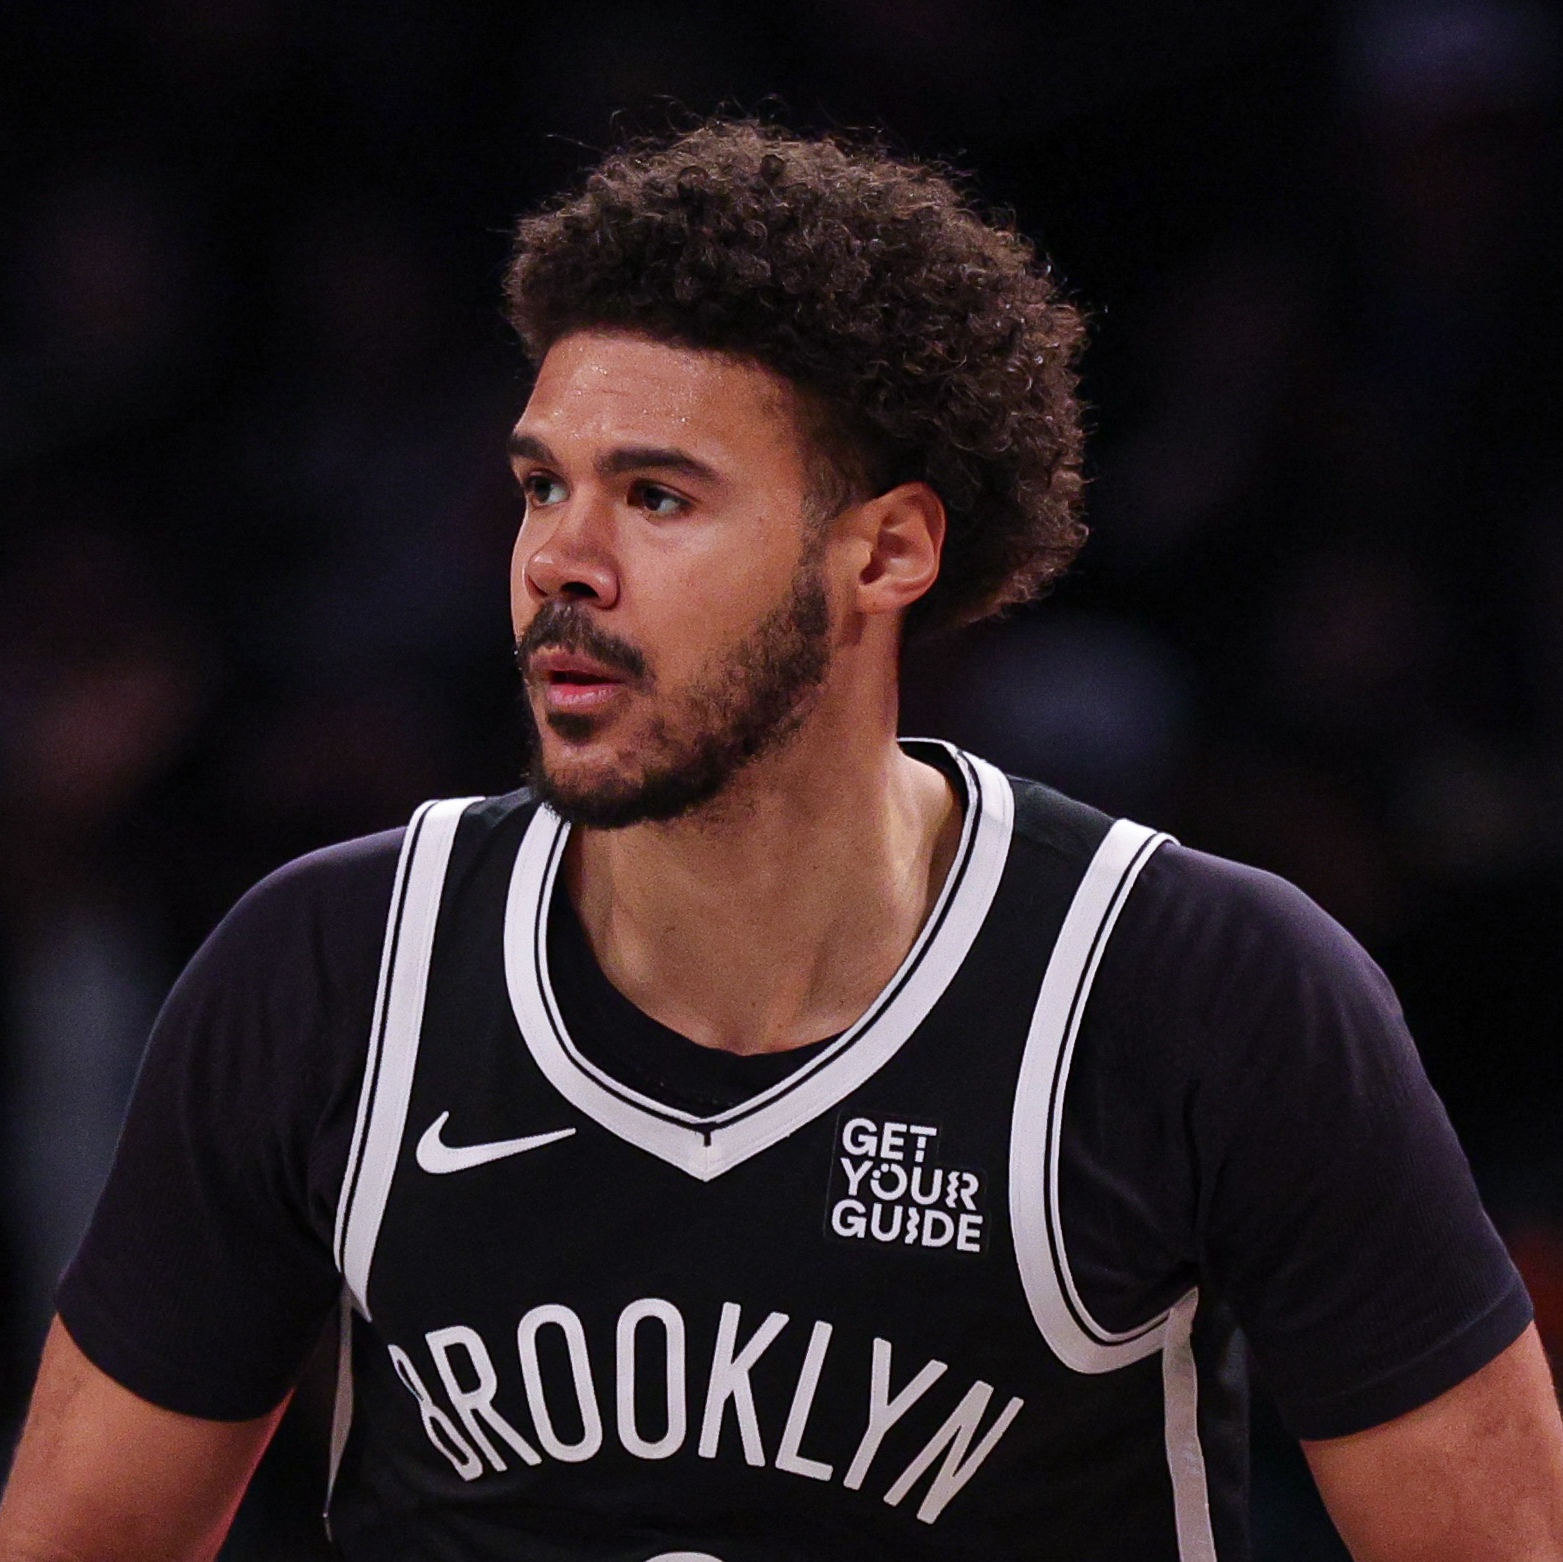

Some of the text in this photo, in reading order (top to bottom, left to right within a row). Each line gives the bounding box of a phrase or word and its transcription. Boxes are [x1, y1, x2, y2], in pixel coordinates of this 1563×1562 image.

[842, 1117, 938, 1163] GET
[840, 1157, 979, 1210] YOUR
[831, 1199, 984, 1252] GUIDE
[388, 1298, 1024, 1525] BROOKLYN
